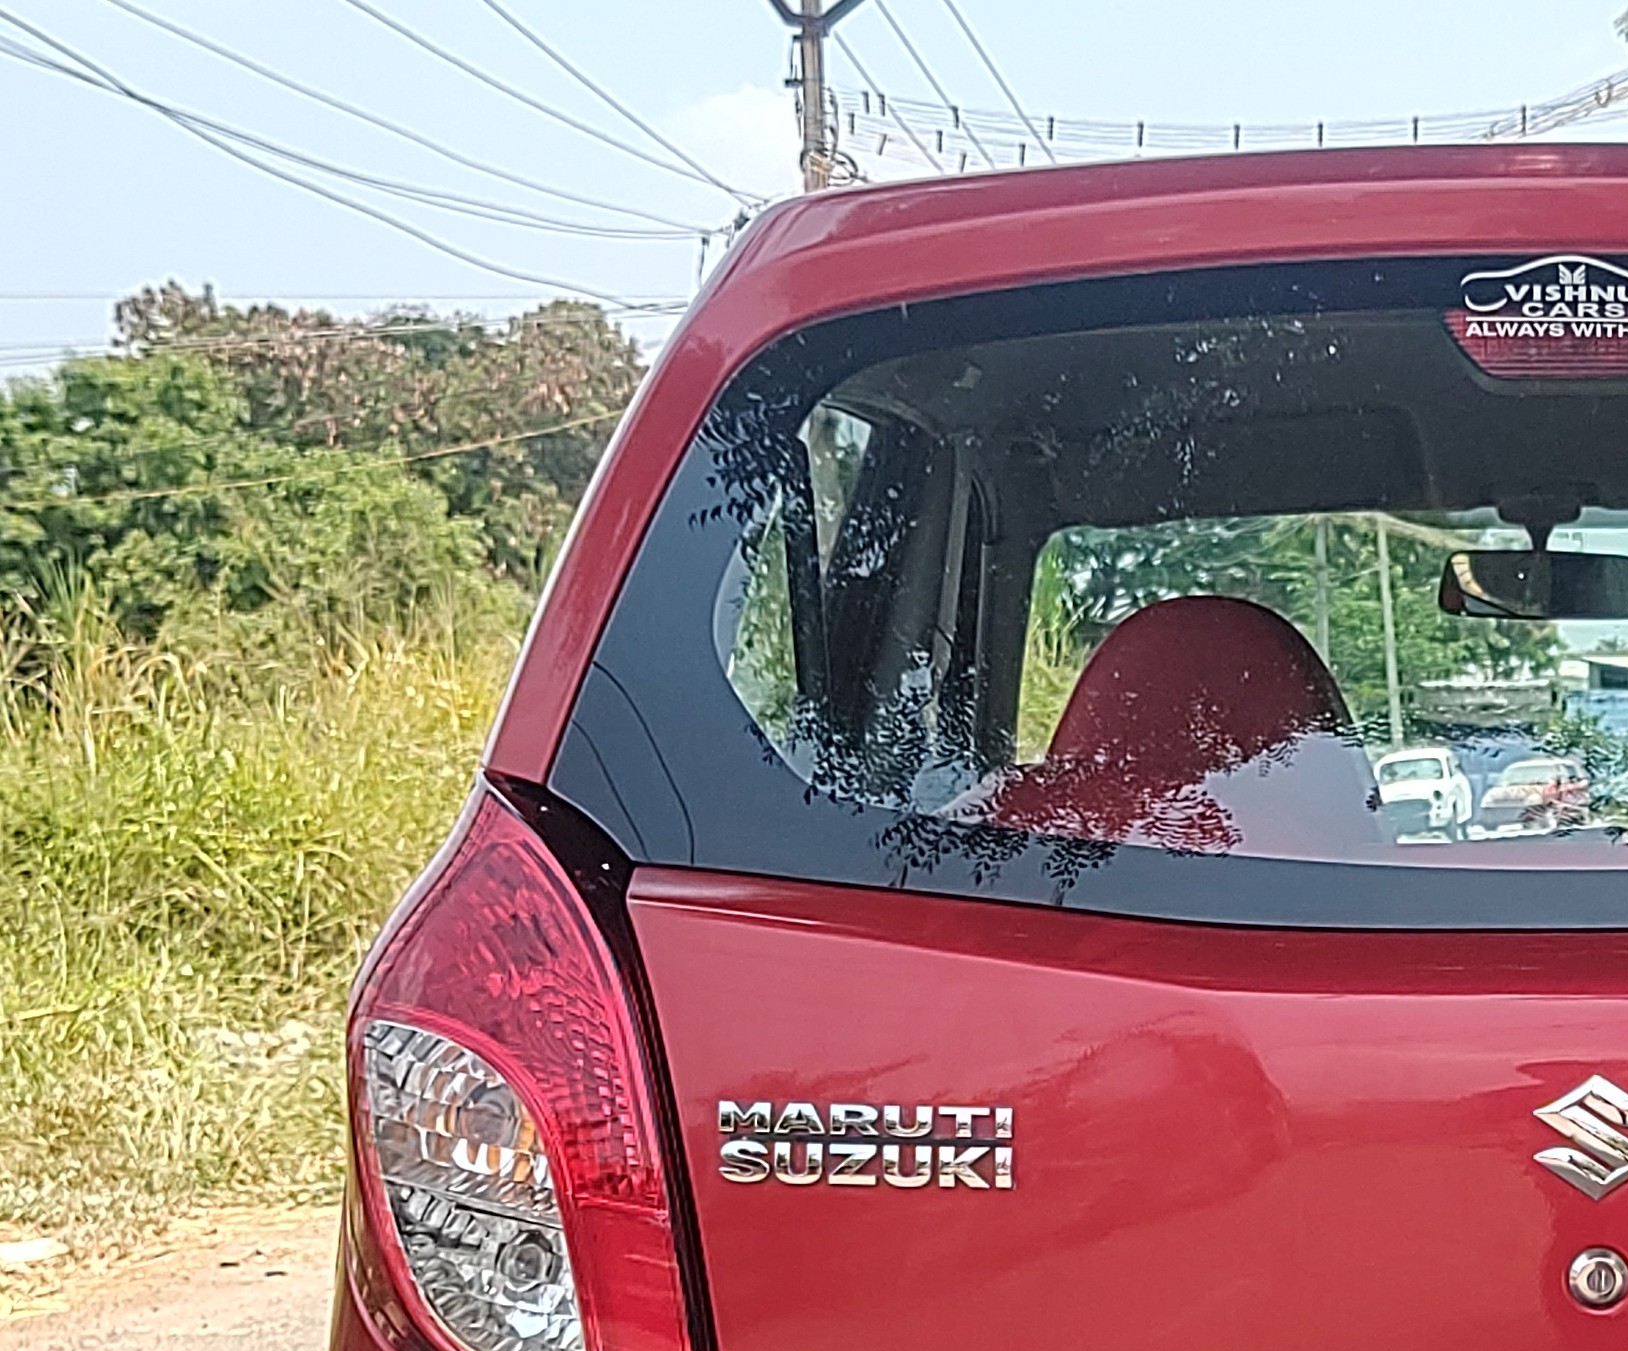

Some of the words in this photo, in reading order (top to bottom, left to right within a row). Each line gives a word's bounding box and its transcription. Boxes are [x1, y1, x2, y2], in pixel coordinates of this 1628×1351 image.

[1521, 302, 1626, 318] CARS
[1465, 322, 1565, 338] ALWAYS
[718, 1100, 1013, 1139] MARUTI
[718, 1141, 1014, 1189] SUZUKI
